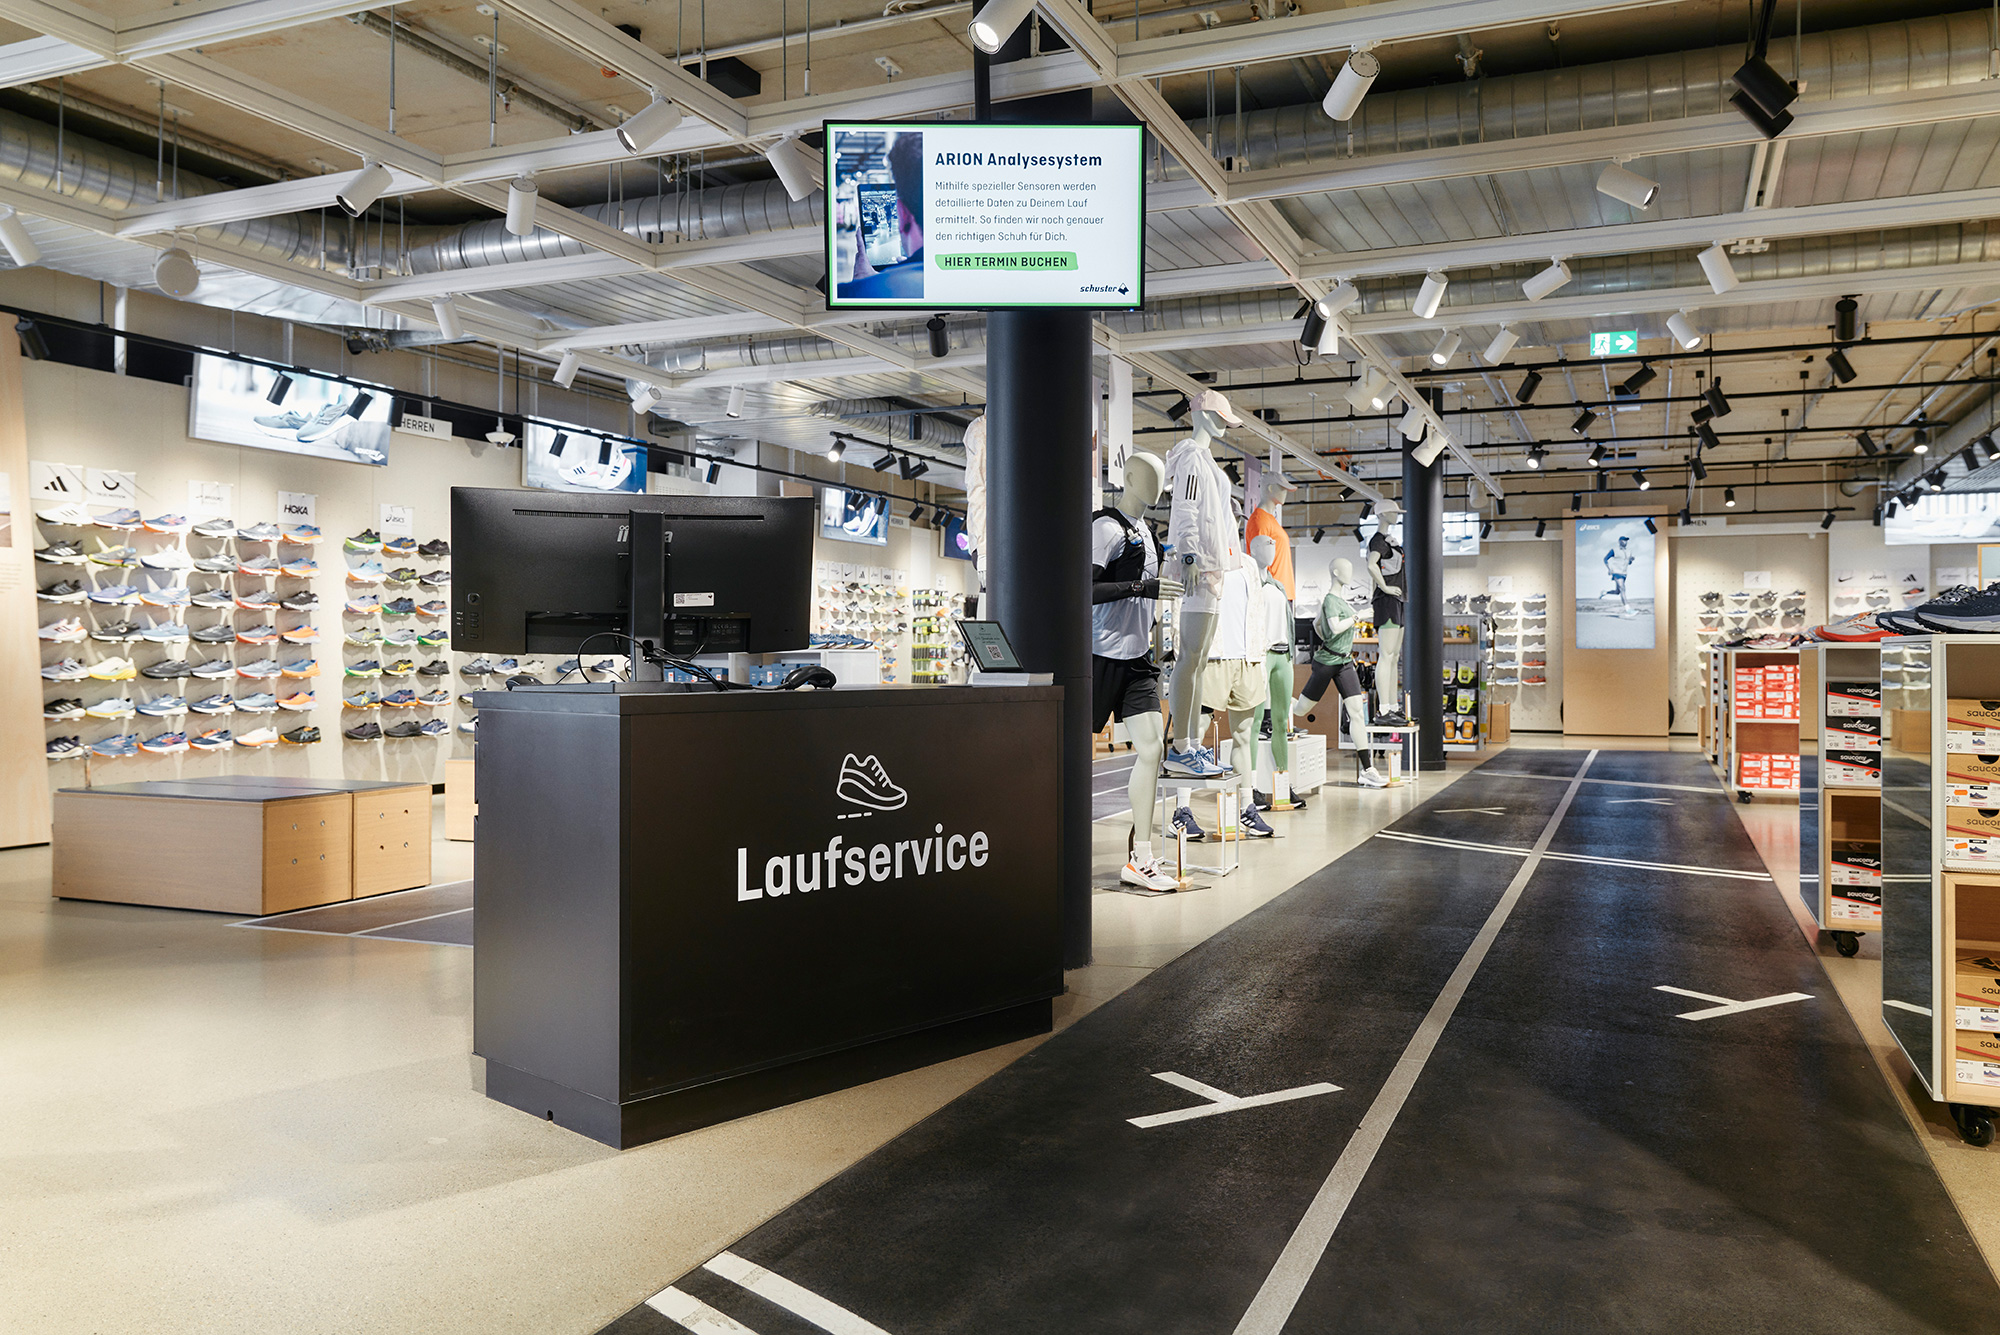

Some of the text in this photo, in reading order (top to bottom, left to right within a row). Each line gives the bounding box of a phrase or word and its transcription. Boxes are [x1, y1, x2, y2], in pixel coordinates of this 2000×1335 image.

[935, 152, 1102, 170] ARION Analysesystem
[935, 181, 1097, 194] Mithilfe spezieller Sensoren werden
[935, 198, 1088, 208] detaillierte Daten zu Deinem Lauf
[935, 215, 1104, 227] ermittelt. So finden wir noch genauer
[935, 231, 1068, 244] den richtigen Schuh für Dich.
[944, 256, 1068, 267] HIER TERMIN BUCHEN
[1080, 283, 1118, 293] schuster
[401, 418, 435, 433] HERREN
[283, 504, 308, 515] HOKA
[616, 524, 674, 543] iia
[1966, 765, 2000, 773] sauco
[737, 823, 989, 902] Laufservice
